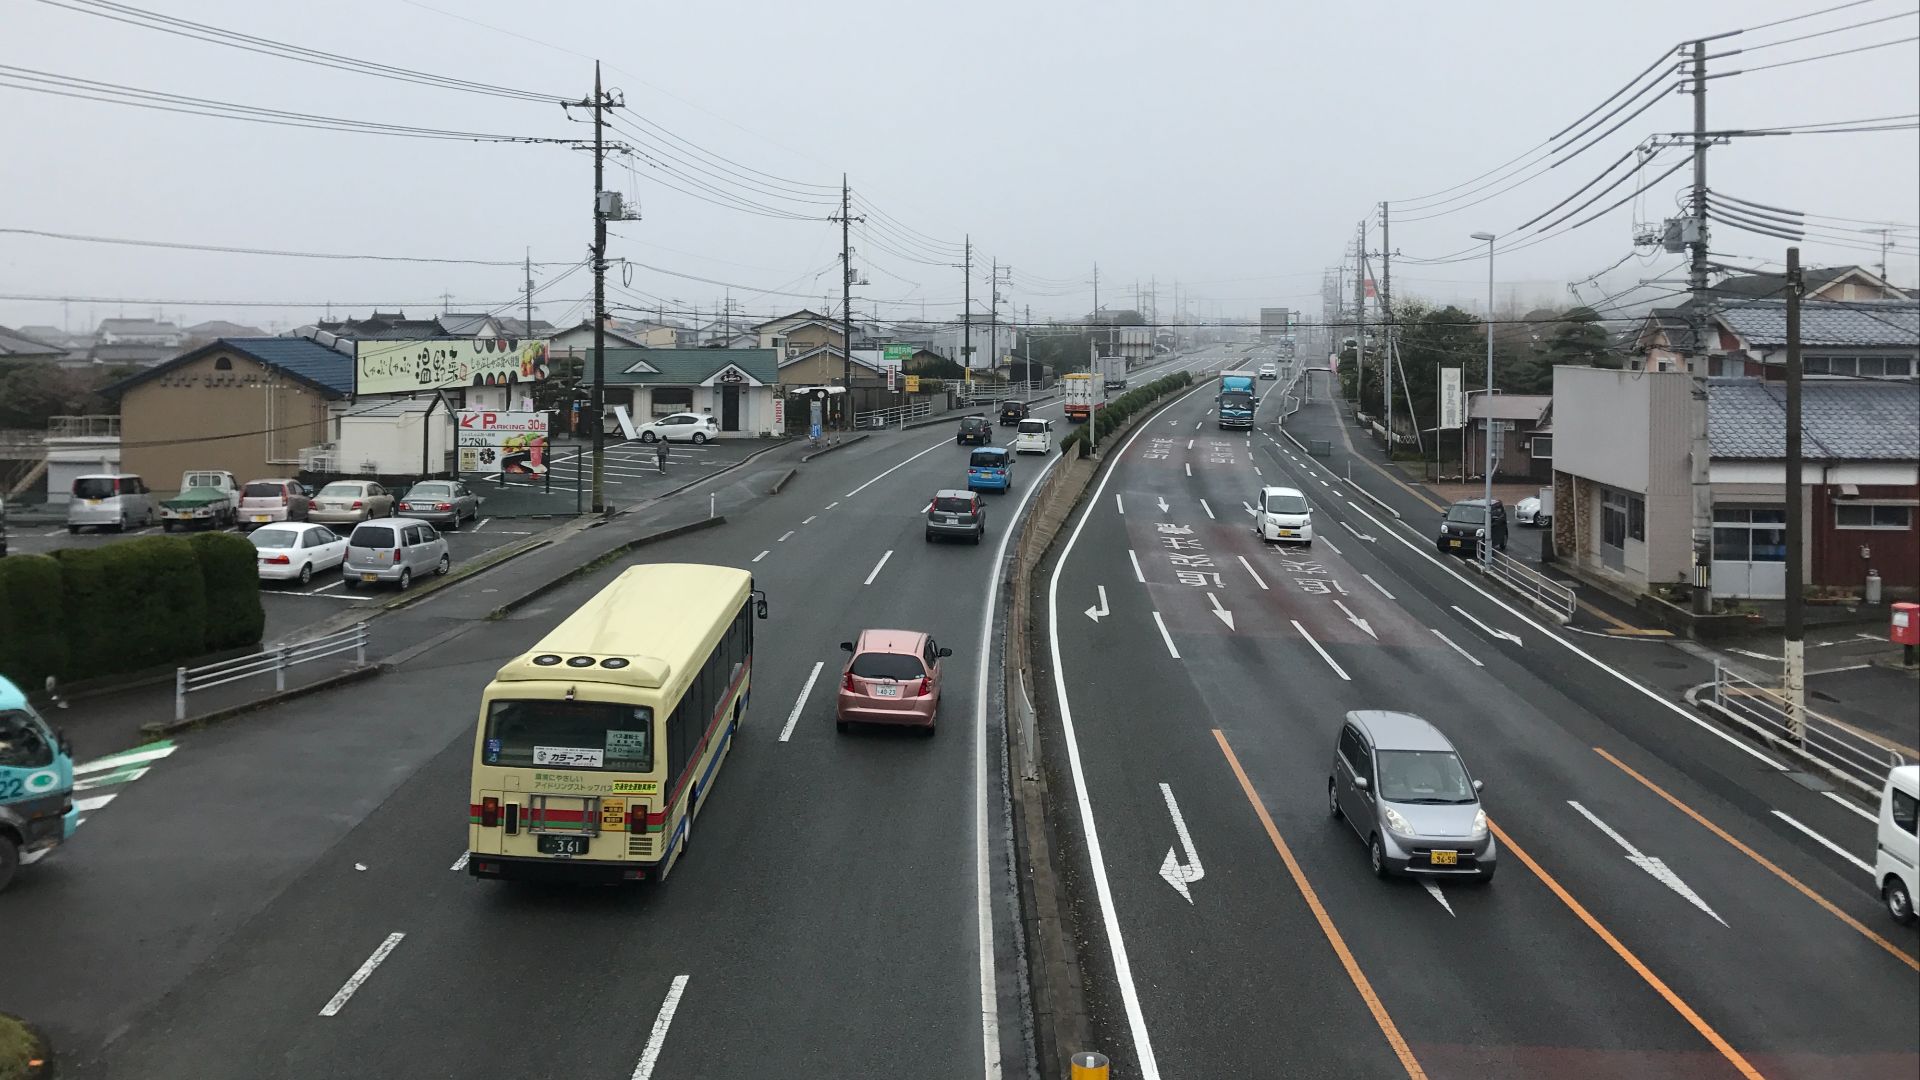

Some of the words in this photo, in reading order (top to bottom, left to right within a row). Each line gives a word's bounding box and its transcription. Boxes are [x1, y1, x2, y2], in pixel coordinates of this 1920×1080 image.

[362, 356, 412, 378] しゃぶしゃぶ
[415, 346, 459, 385] 温野菜
[482, 413, 526, 430] PARKING
[527, 419, 546, 430] 30台
[775, 400, 783, 424] KIRIN
[460, 437, 487, 447] 2780
[1262, 542, 1350, 597] 追突注
[550, 753, 597, 763] カラーアート
